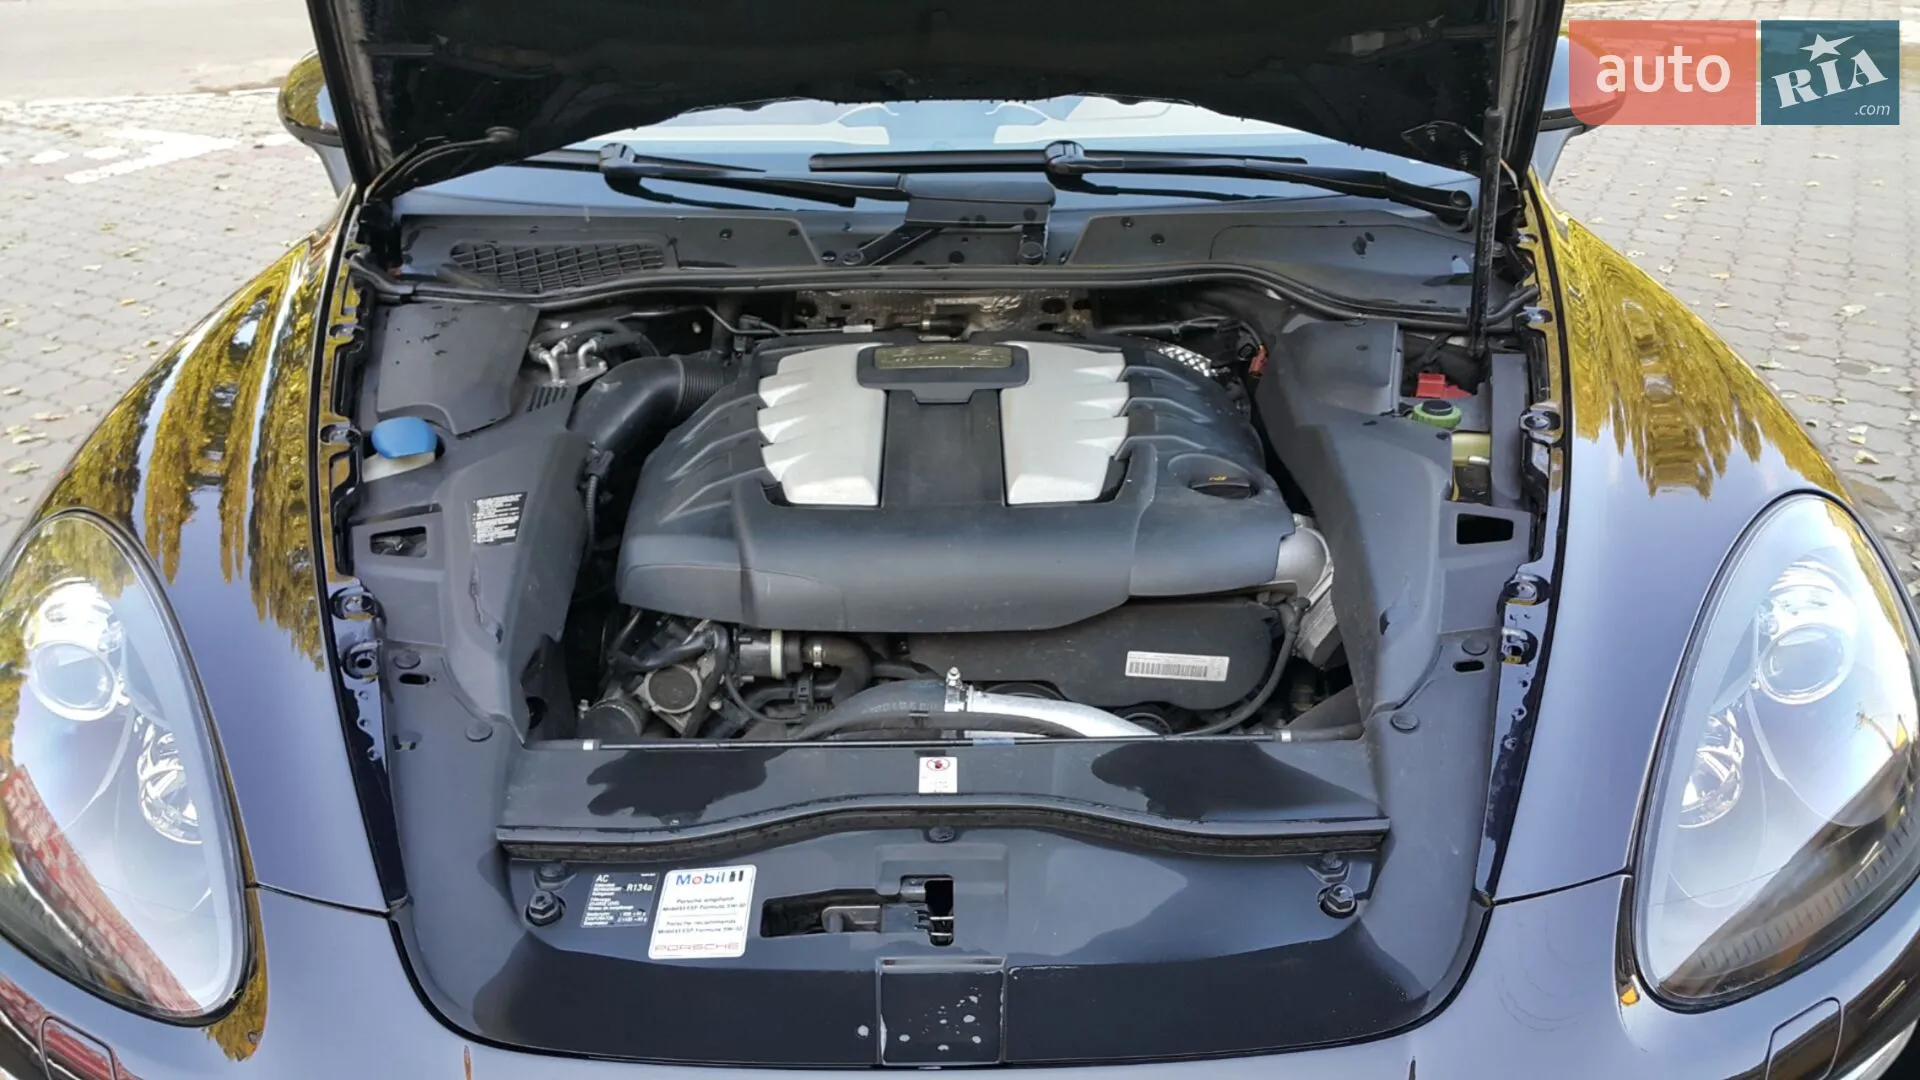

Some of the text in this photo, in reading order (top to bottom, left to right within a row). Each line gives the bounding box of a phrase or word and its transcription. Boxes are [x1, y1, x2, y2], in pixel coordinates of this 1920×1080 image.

[595, 874, 609, 883] AC
[675, 871, 726, 886] Mobil
[626, 883, 653, 892] R134a
[654, 942, 740, 951] PORSCHE
